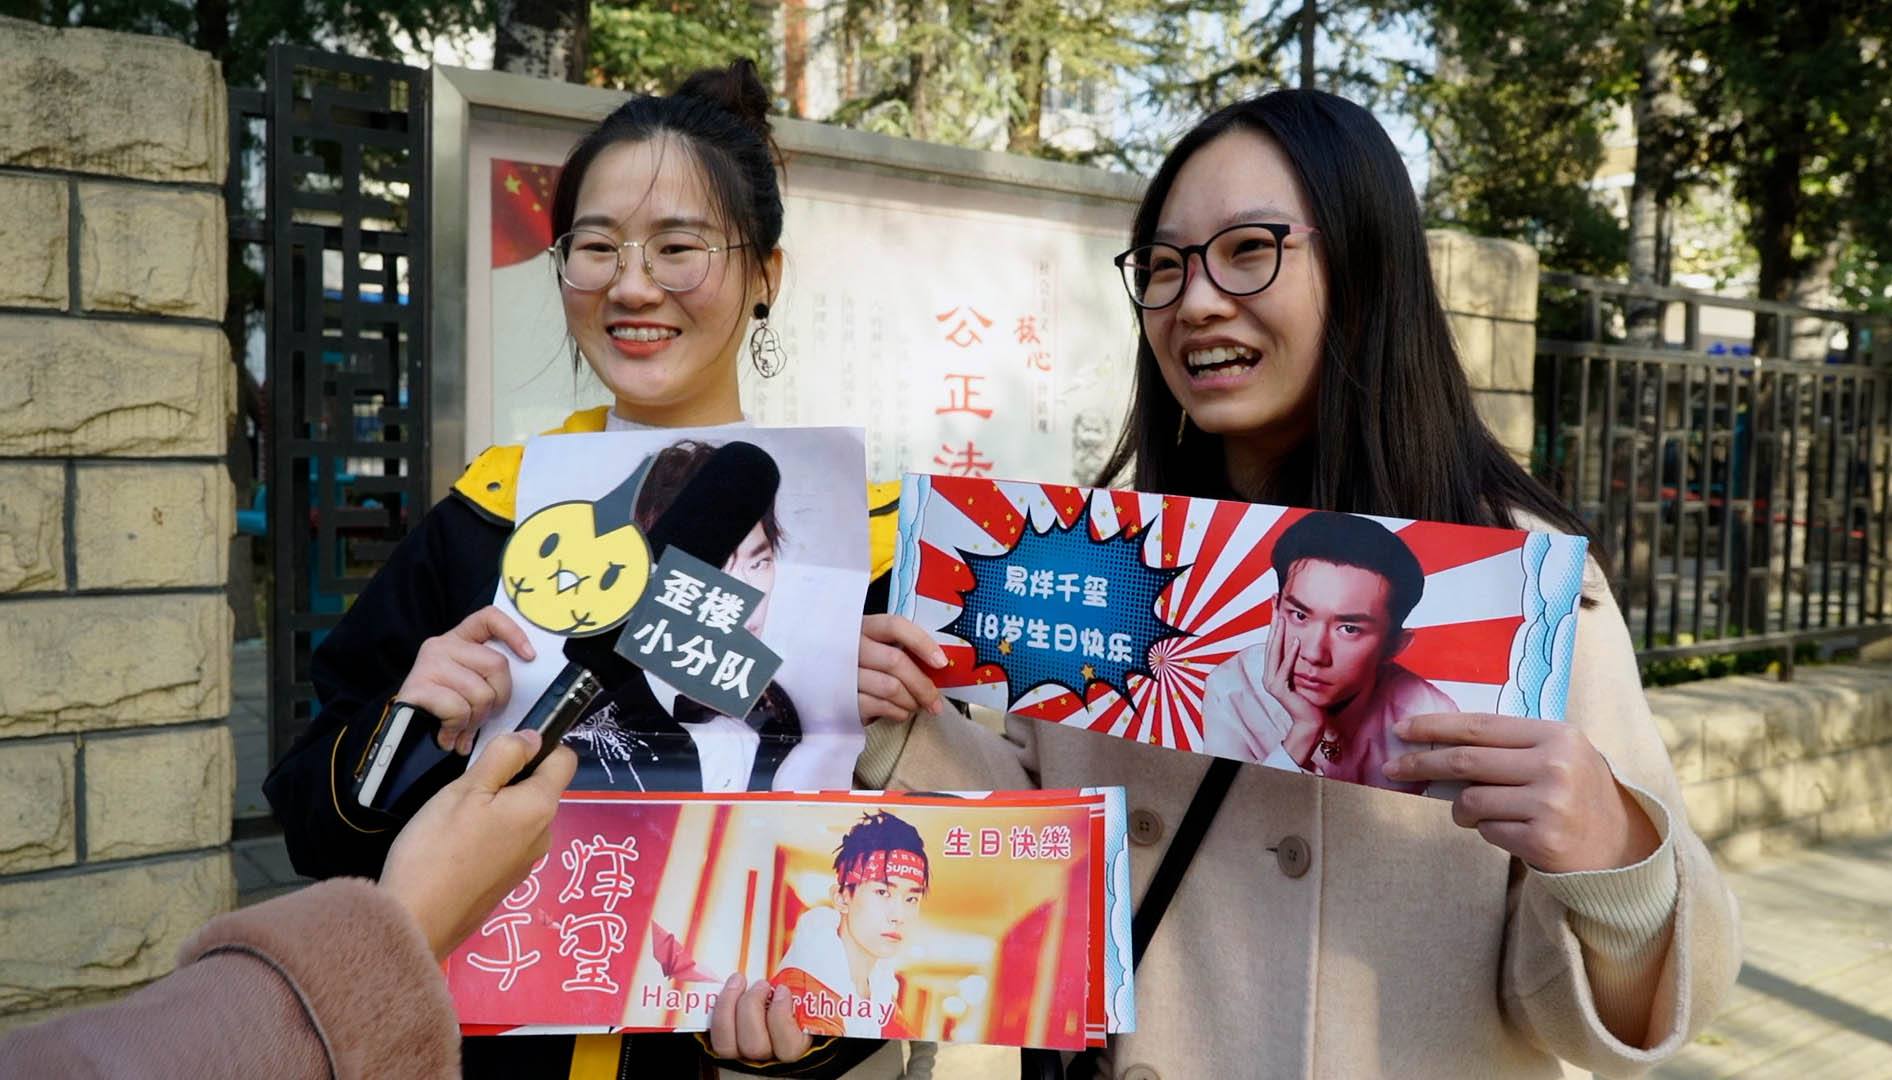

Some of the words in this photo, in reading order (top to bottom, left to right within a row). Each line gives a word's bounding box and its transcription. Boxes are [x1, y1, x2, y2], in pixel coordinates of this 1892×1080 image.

[654, 569, 745, 634] 歪楼
[1003, 565, 1108, 608] 易烊千玺
[633, 618, 756, 699] 小分队
[975, 612, 1133, 664] 18岁生日快乐
[943, 825, 1072, 860] 生日快樂
[771, 991, 896, 1025] rthday
